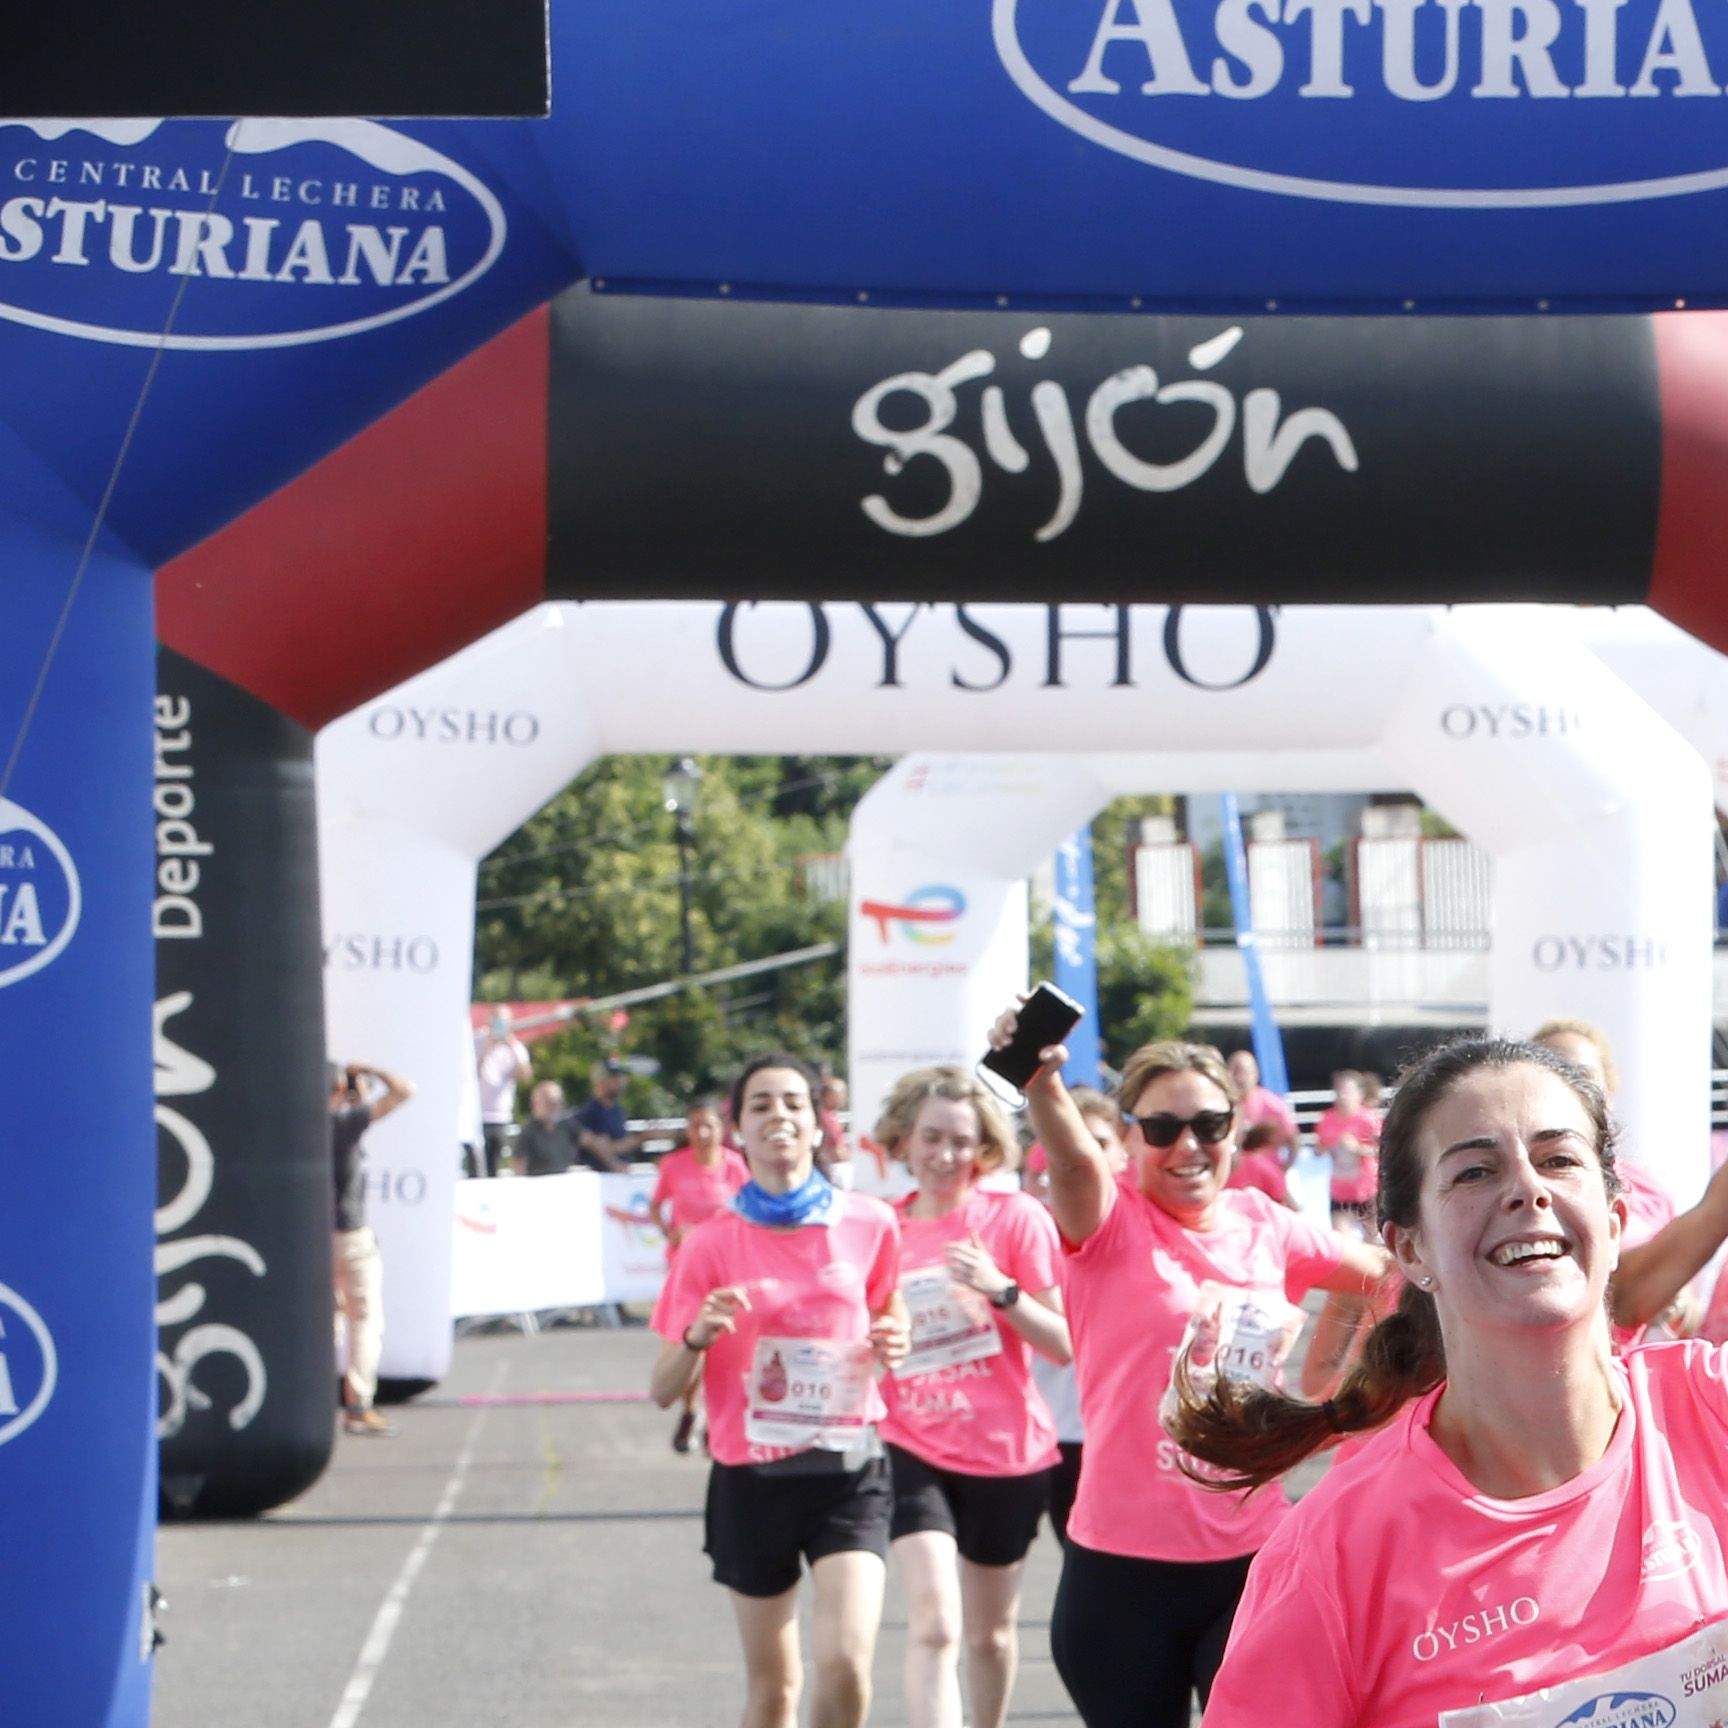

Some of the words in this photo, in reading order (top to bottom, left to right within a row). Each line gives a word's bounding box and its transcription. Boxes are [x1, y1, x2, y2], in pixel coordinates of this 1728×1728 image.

[14, 158, 219, 196] CENTRAL
[241, 174, 447, 212] LECHERA
[851, 324, 1359, 542] gijón
[716, 601, 1275, 692] OYSHO
[369, 707, 541, 748] OYSHO
[155, 693, 214, 939] Deporte
[1412, 1595, 1541, 1662] OYSHO
